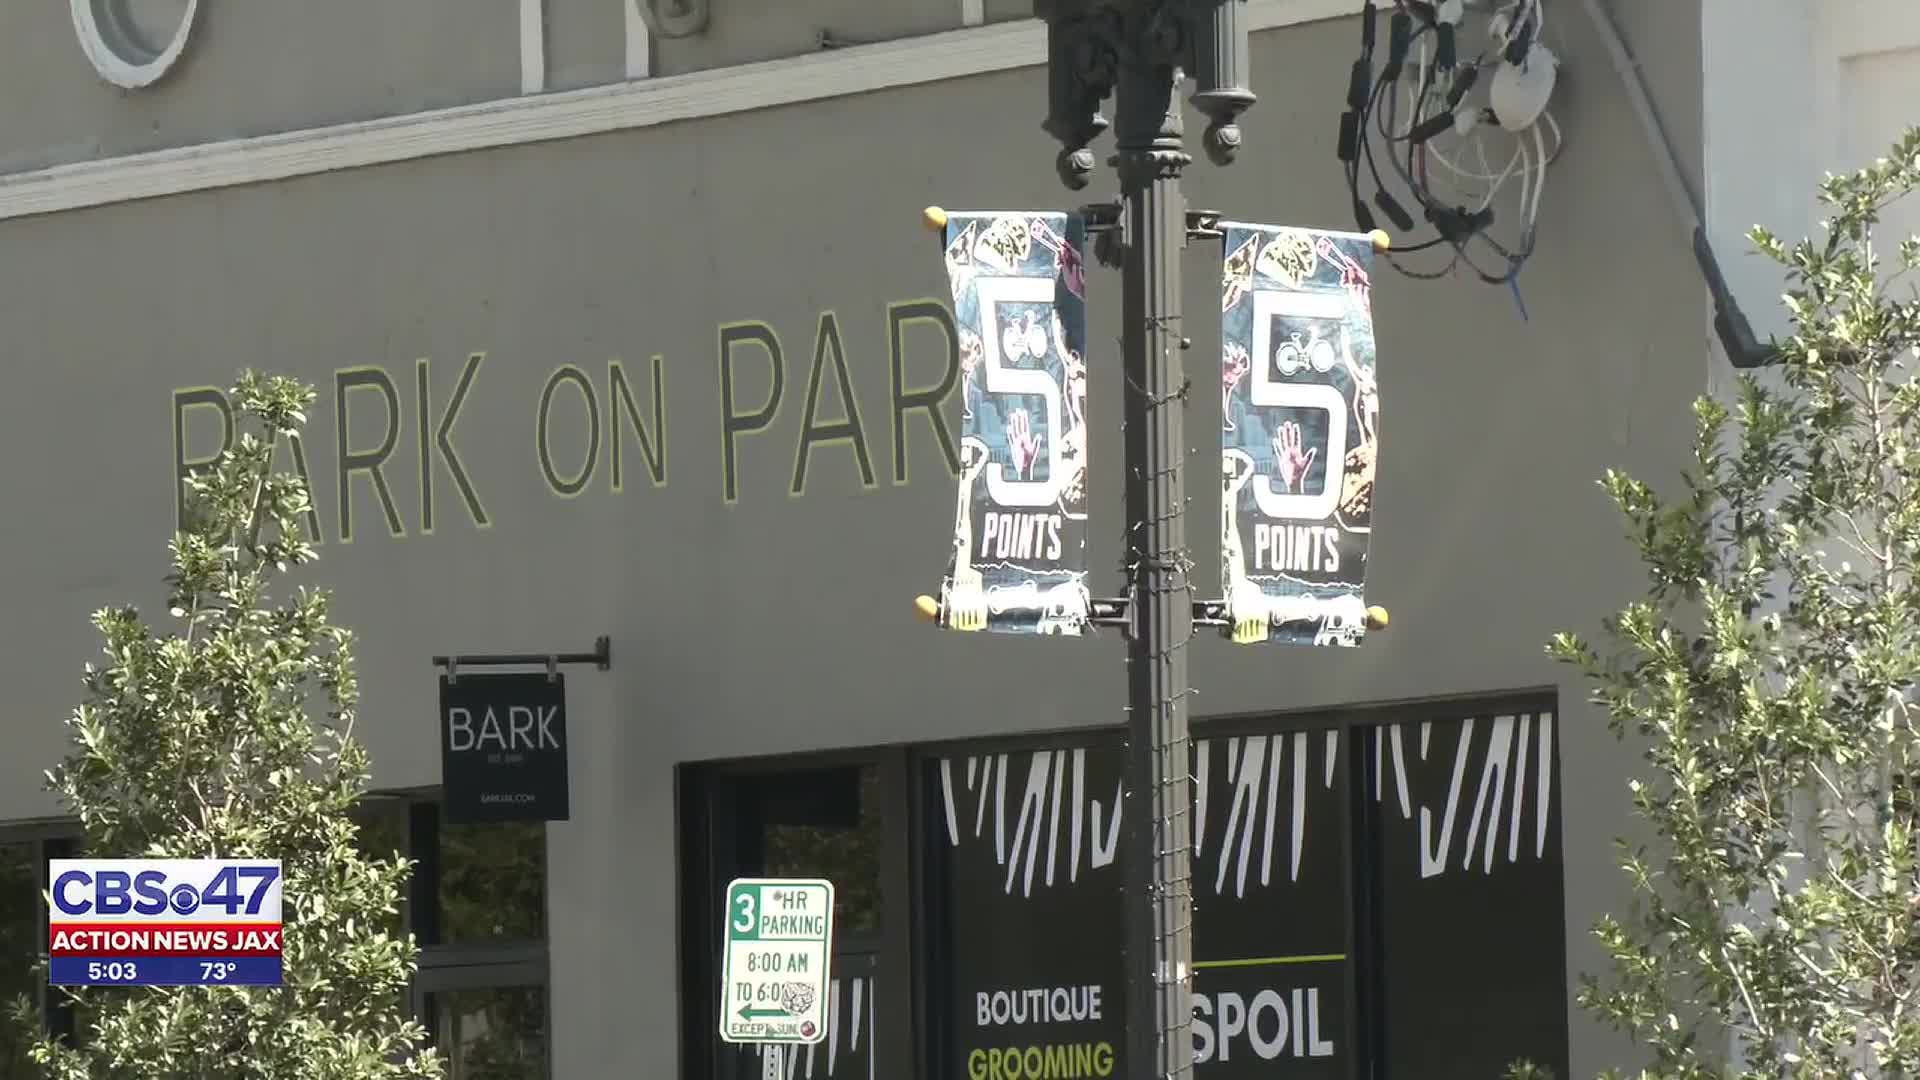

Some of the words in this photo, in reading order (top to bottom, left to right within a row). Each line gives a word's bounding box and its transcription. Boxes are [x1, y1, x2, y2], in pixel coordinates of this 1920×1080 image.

[975, 275, 1062, 508] 5
[1251, 289, 1348, 520] 5
[172, 350, 492, 555] PARK
[536, 354, 667, 498] ON
[980, 511, 1062, 562] POINTS
[1254, 523, 1339, 573] POINTS
[449, 705, 560, 751] BARK
[733, 893, 756, 933] 3
[782, 891, 808, 911] HR
[761, 915, 824, 935] PARKING
[747, 952, 782, 973] 8:00
[787, 952, 809, 973] AM
[736, 982, 752, 1001] TO
[757, 982, 786, 1001] 6:0
[976, 985, 1102, 1026] BOUTIQUE
[1192, 987, 1334, 1063] SPOIL
[967, 1042, 1115, 1080] GROOMING
